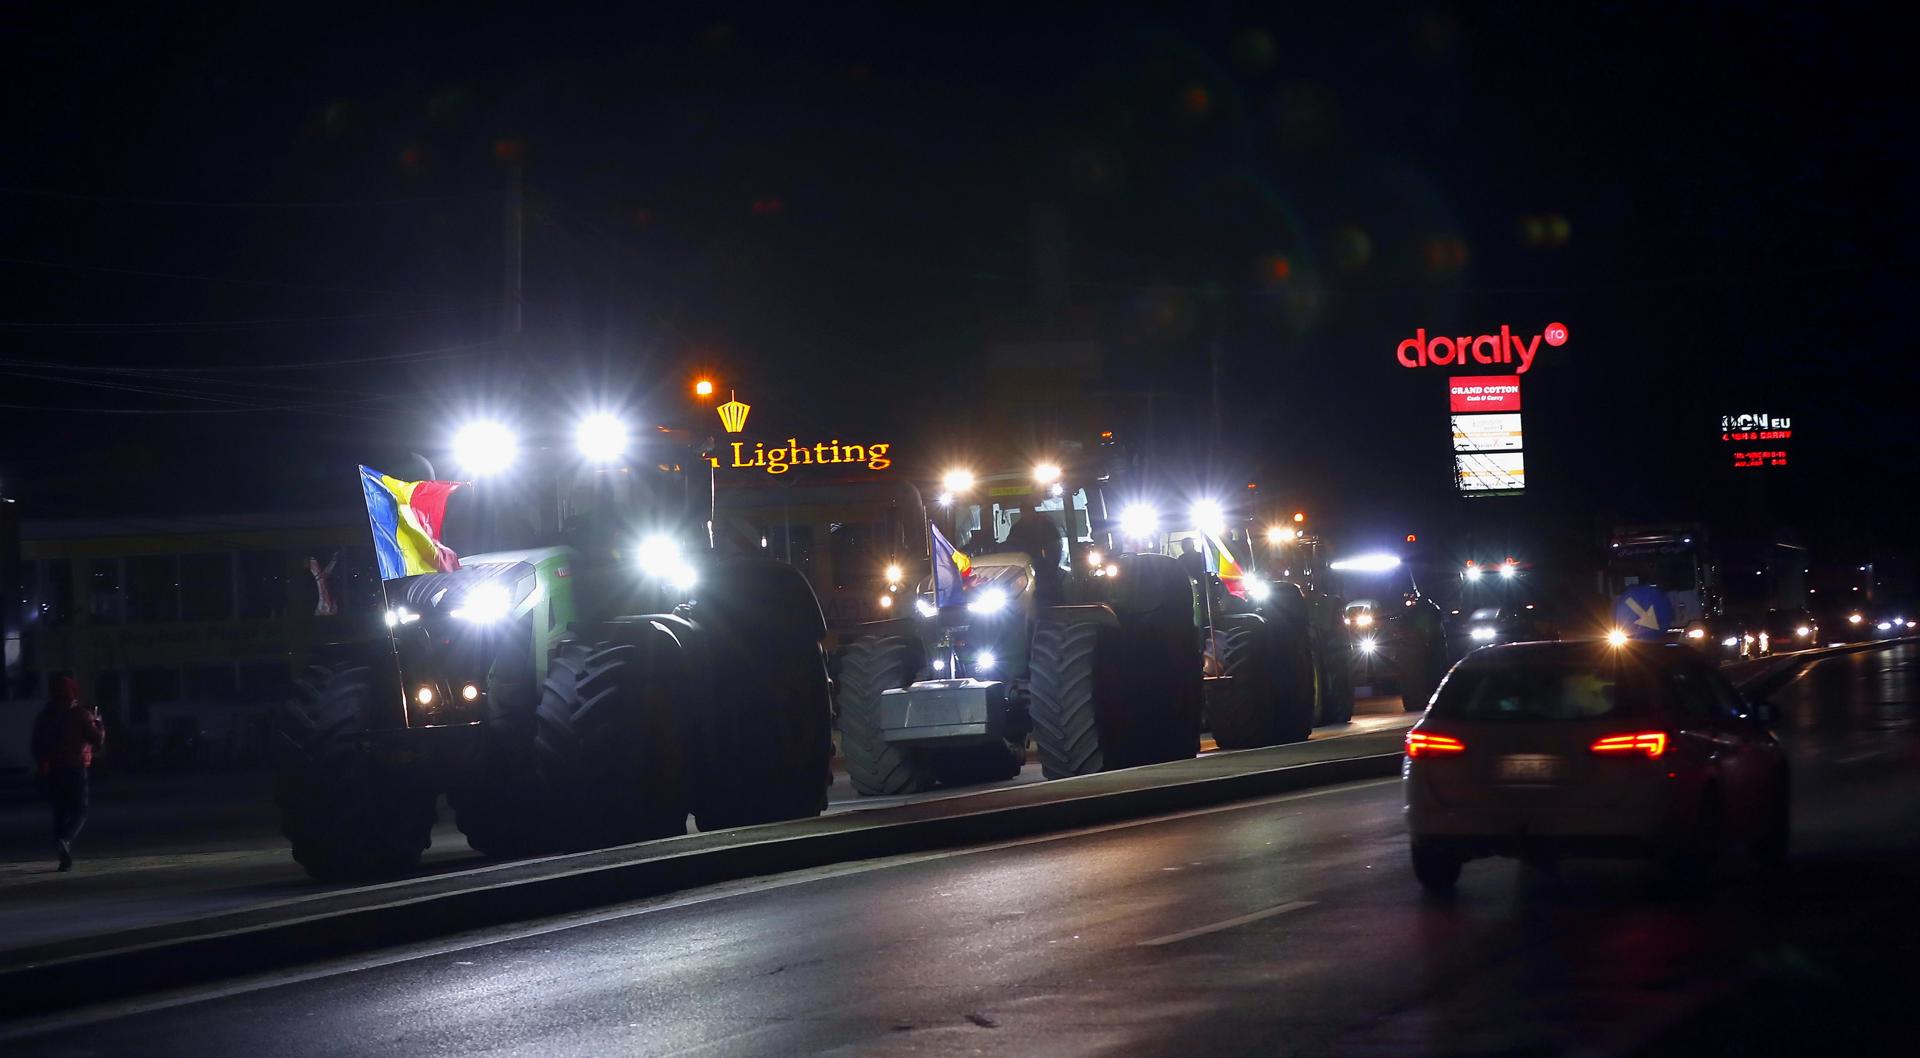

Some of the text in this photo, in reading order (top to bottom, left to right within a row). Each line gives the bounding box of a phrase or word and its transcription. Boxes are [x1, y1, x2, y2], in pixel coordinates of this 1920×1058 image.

[1397, 325, 1542, 374] doraly
[1451, 385, 1519, 395] GRAND COTTON
[1771, 417, 1791, 429] EU
[731, 438, 891, 475] Lighting
